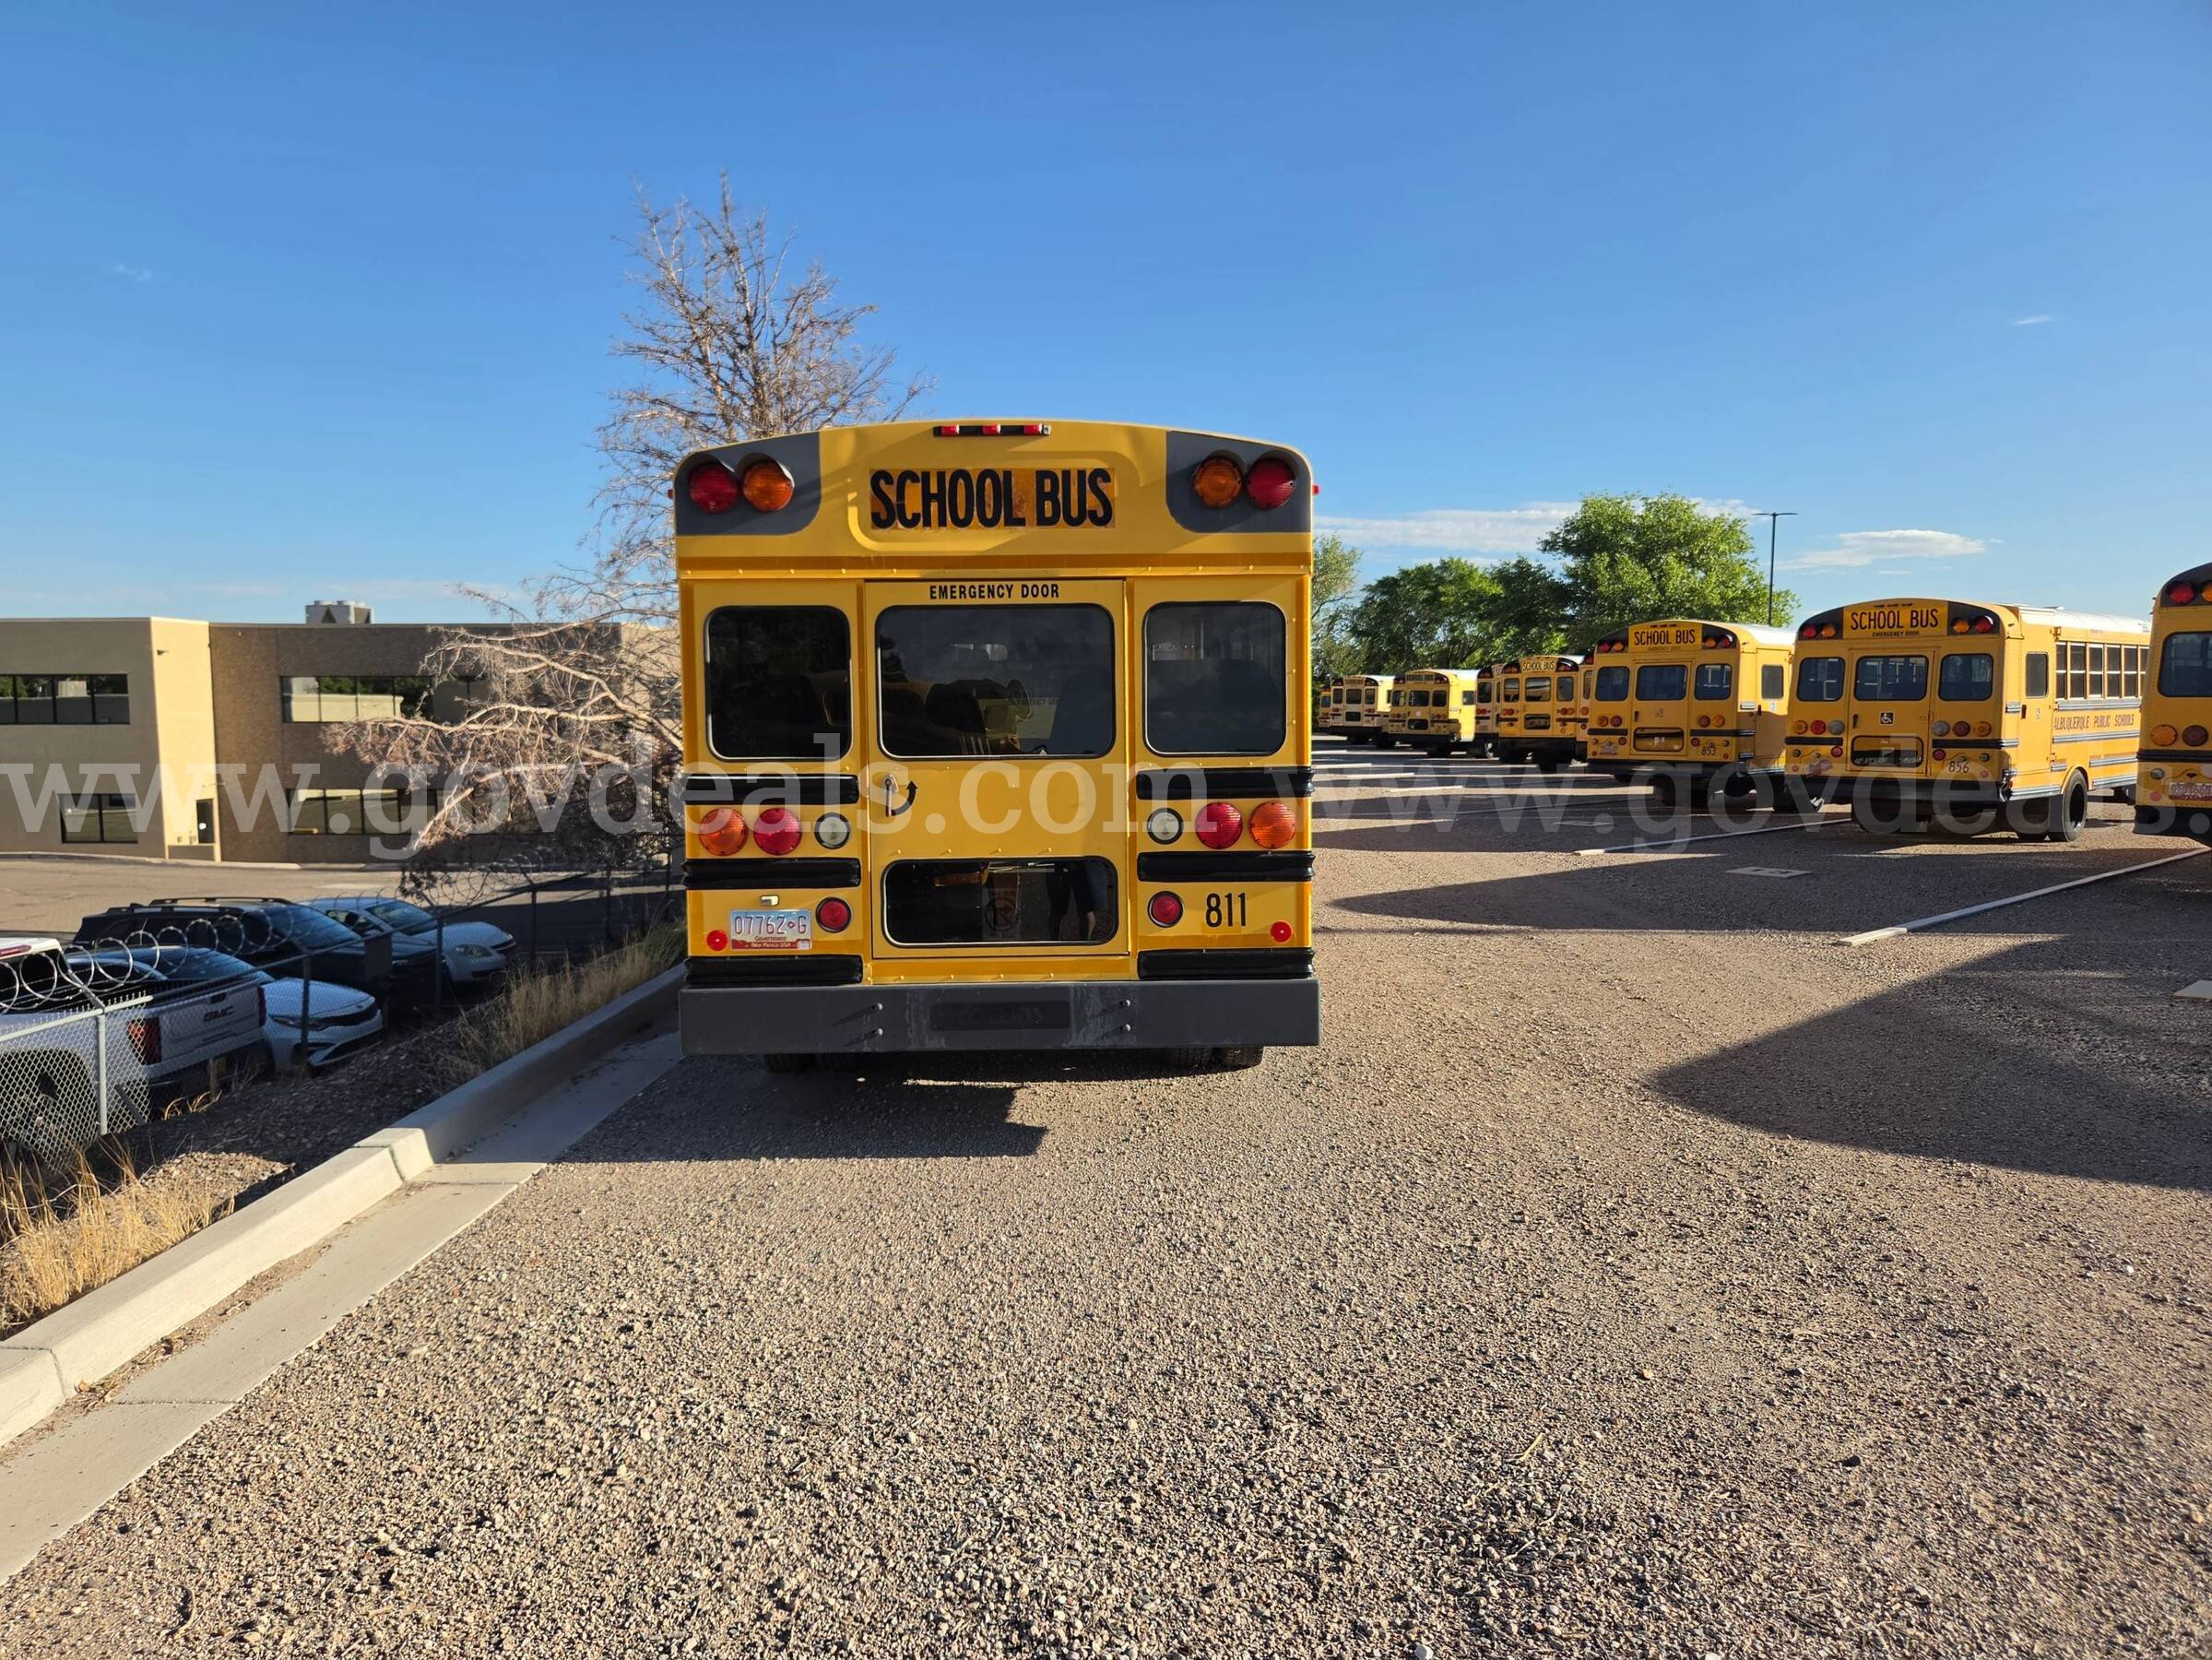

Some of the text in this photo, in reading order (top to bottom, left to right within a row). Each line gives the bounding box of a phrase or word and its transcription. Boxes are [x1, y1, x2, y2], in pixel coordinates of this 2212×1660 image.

[870, 468, 1113, 528] SCHOOL BUS
[929, 584, 1059, 599] EMERGENCY DOOR
[1851, 609, 1939, 630] SCHOOL BUS
[1634, 629, 1696, 646] SCHOOL BUS
[1948, 761, 1970, 774] 856
[1205, 892, 1247, 928] 811
